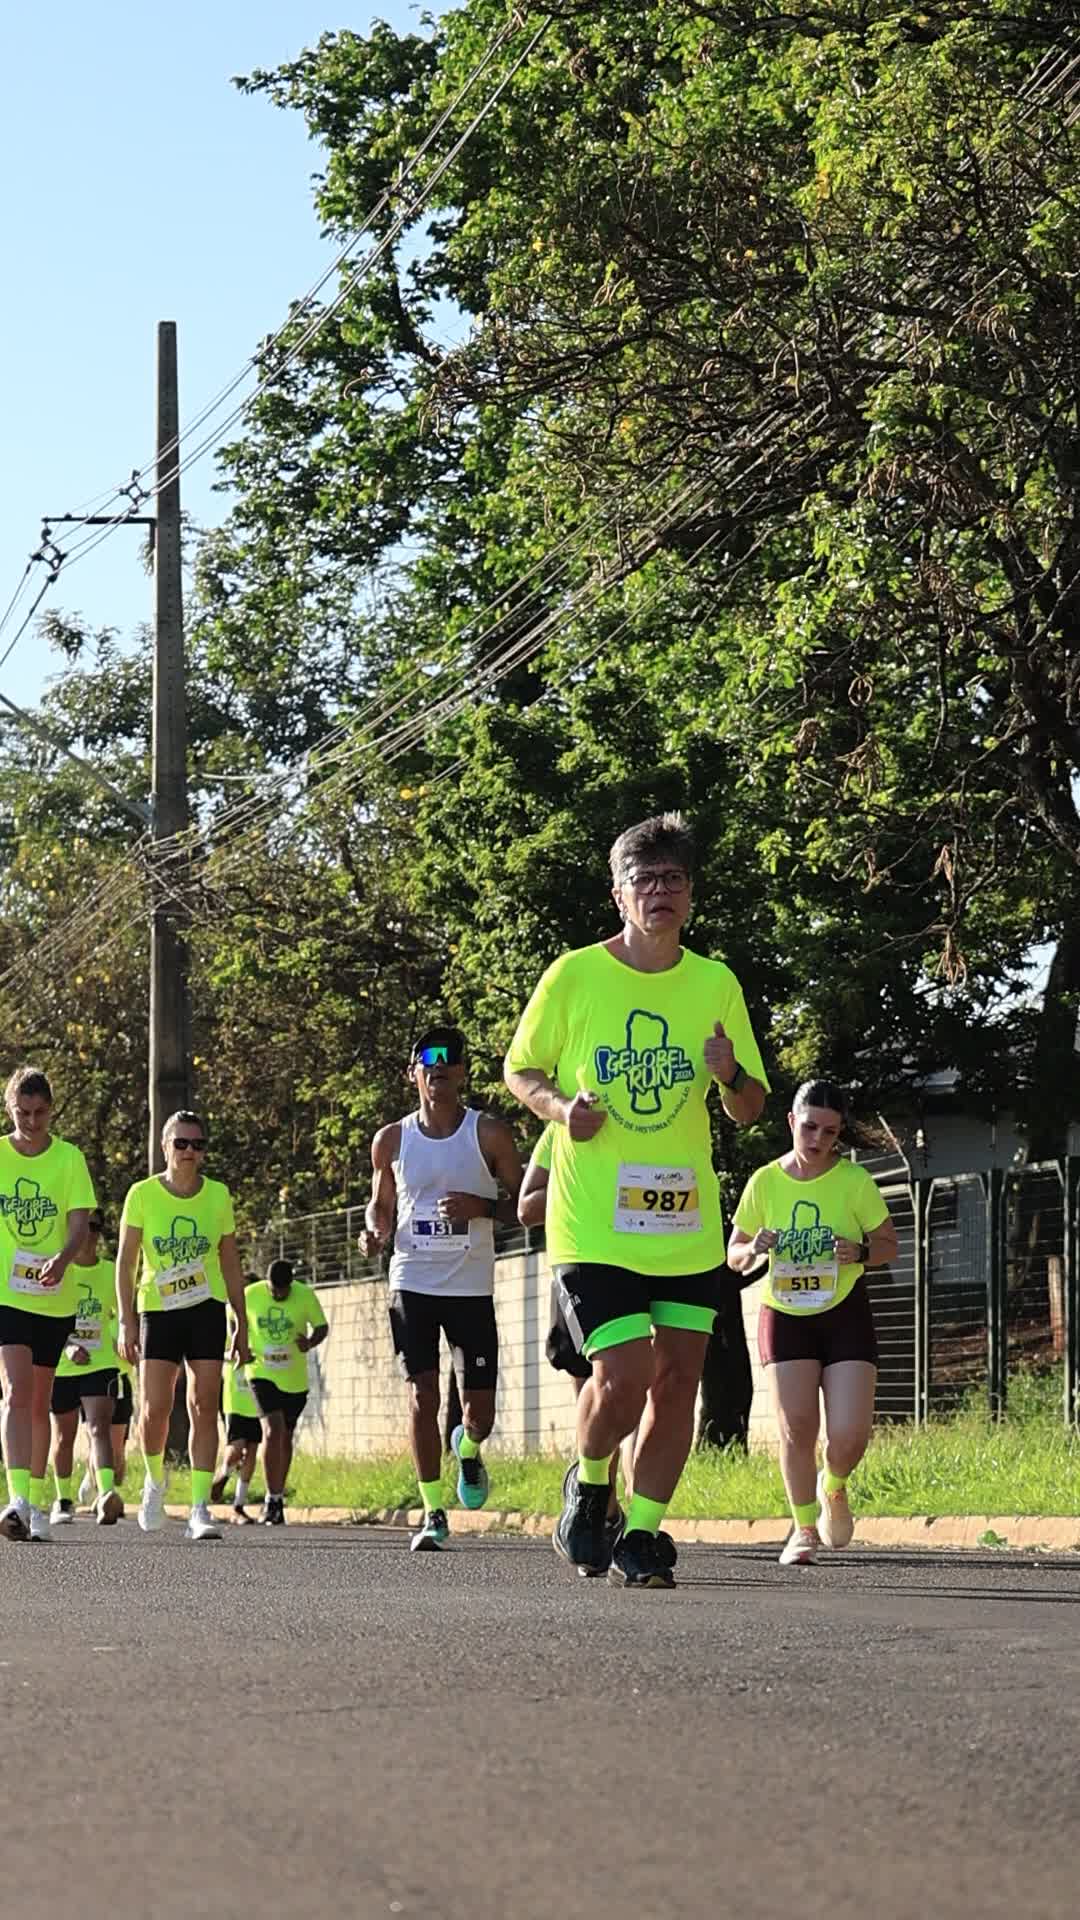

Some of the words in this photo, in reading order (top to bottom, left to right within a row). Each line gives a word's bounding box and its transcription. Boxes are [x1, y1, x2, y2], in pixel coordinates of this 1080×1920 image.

[606, 1049, 691, 1074] GELOBEL
[628, 1064, 673, 1094] RUN
[643, 1189, 690, 1212] 987
[16, 1207, 44, 1224] RUN
[790, 1236, 823, 1260] RUN
[170, 1275, 197, 1294] 704
[791, 1276, 820, 1291] 513
